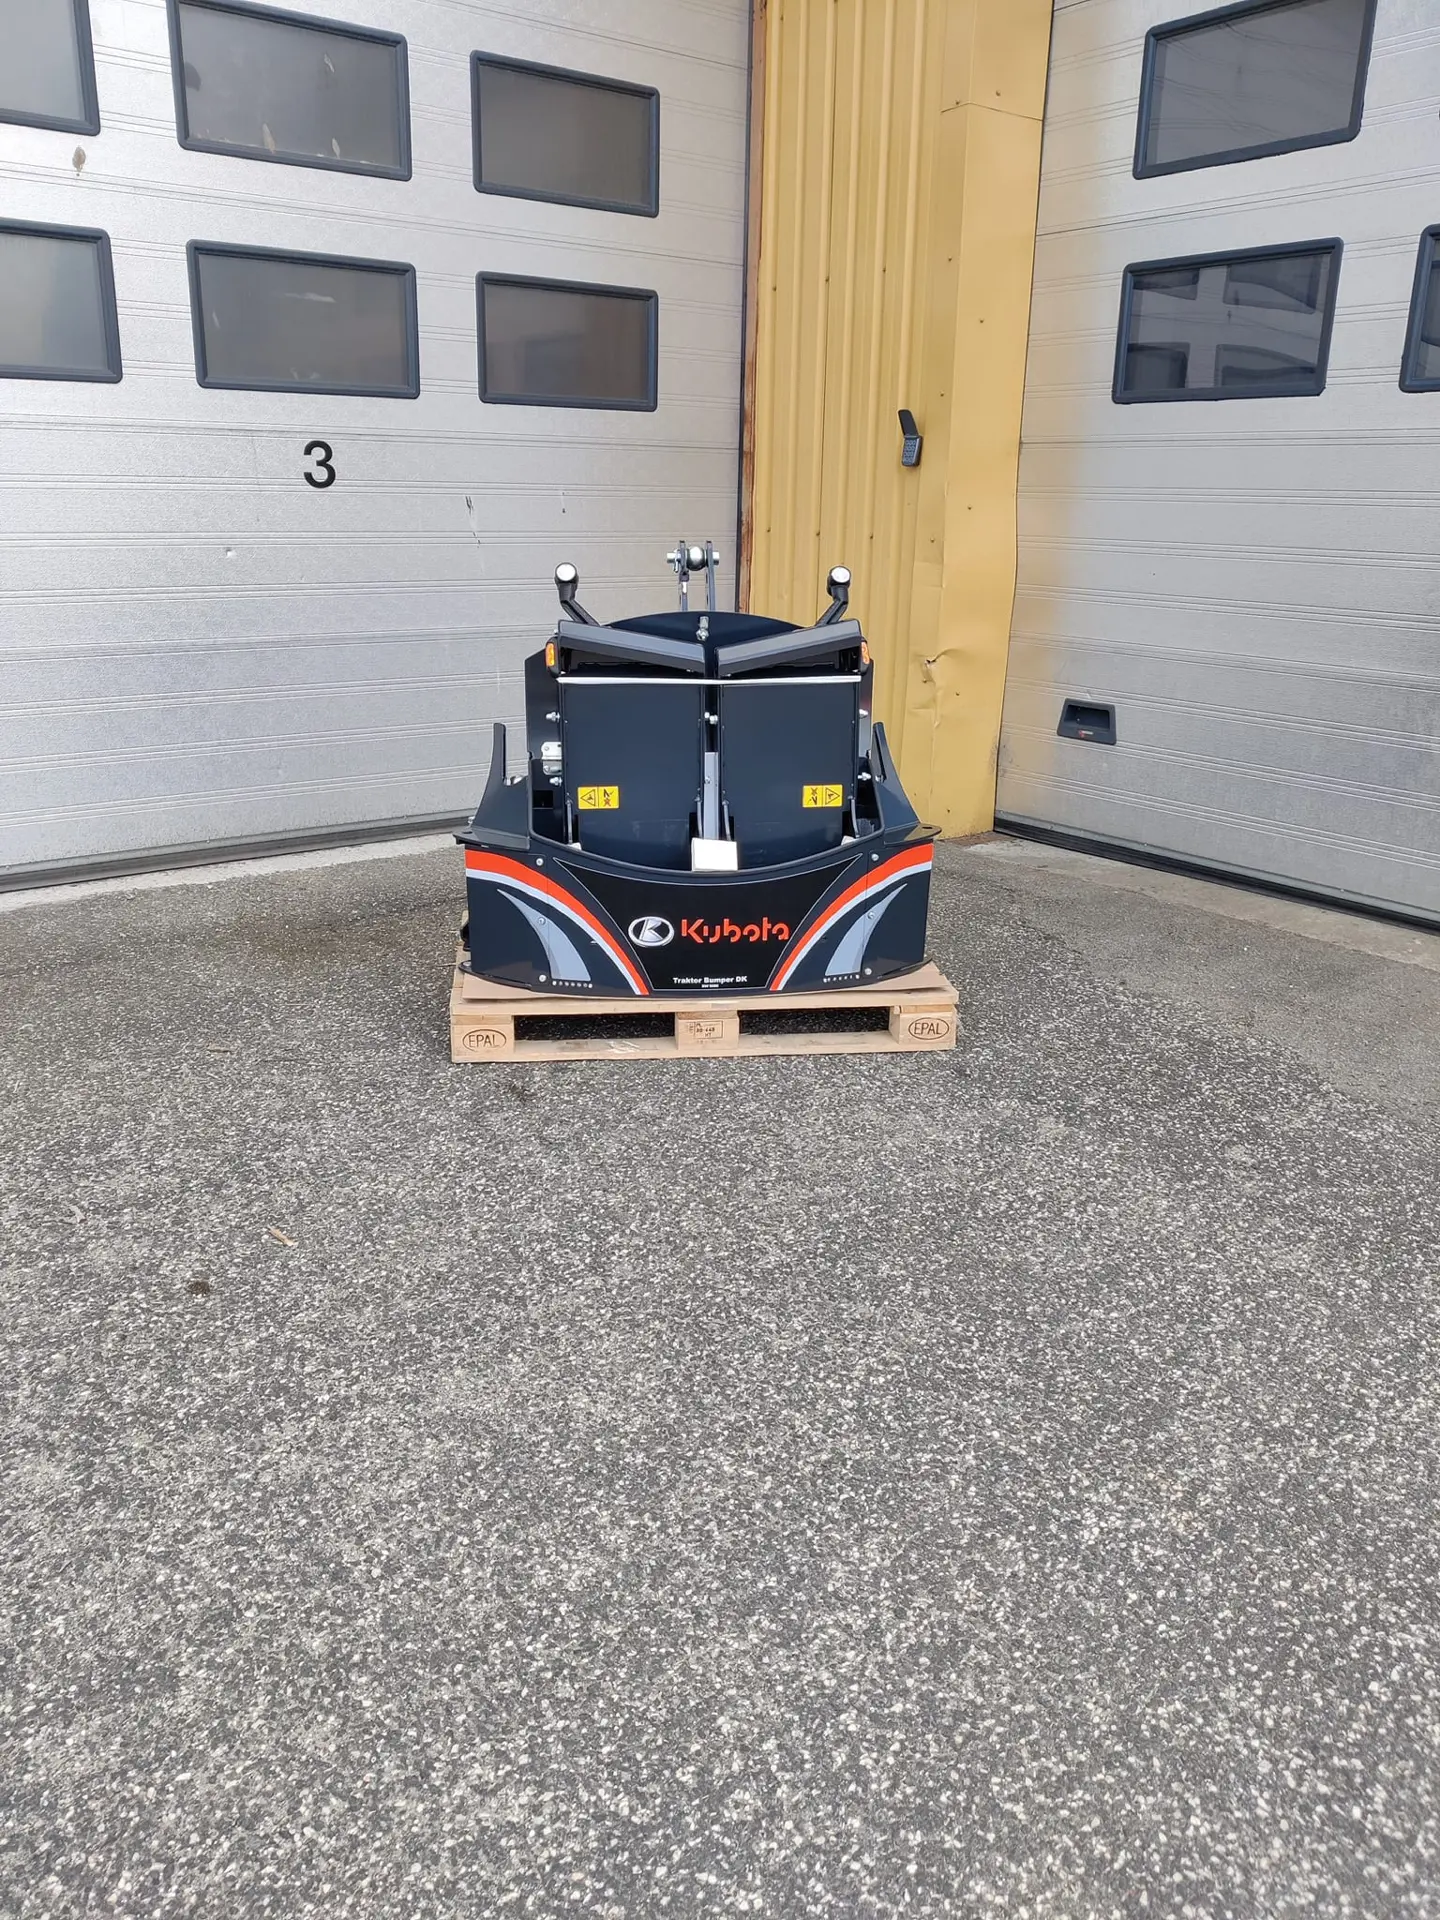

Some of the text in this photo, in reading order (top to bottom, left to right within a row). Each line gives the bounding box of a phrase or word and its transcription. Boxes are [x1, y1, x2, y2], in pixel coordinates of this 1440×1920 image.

[304, 441, 335, 488] 3
[681, 916, 790, 944] Kubota
[703, 976, 734, 985] Bumper
[735, 975, 748, 983] DK
[914, 1022, 941, 1036] EPAL
[468, 1034, 499, 1048] EPAL
